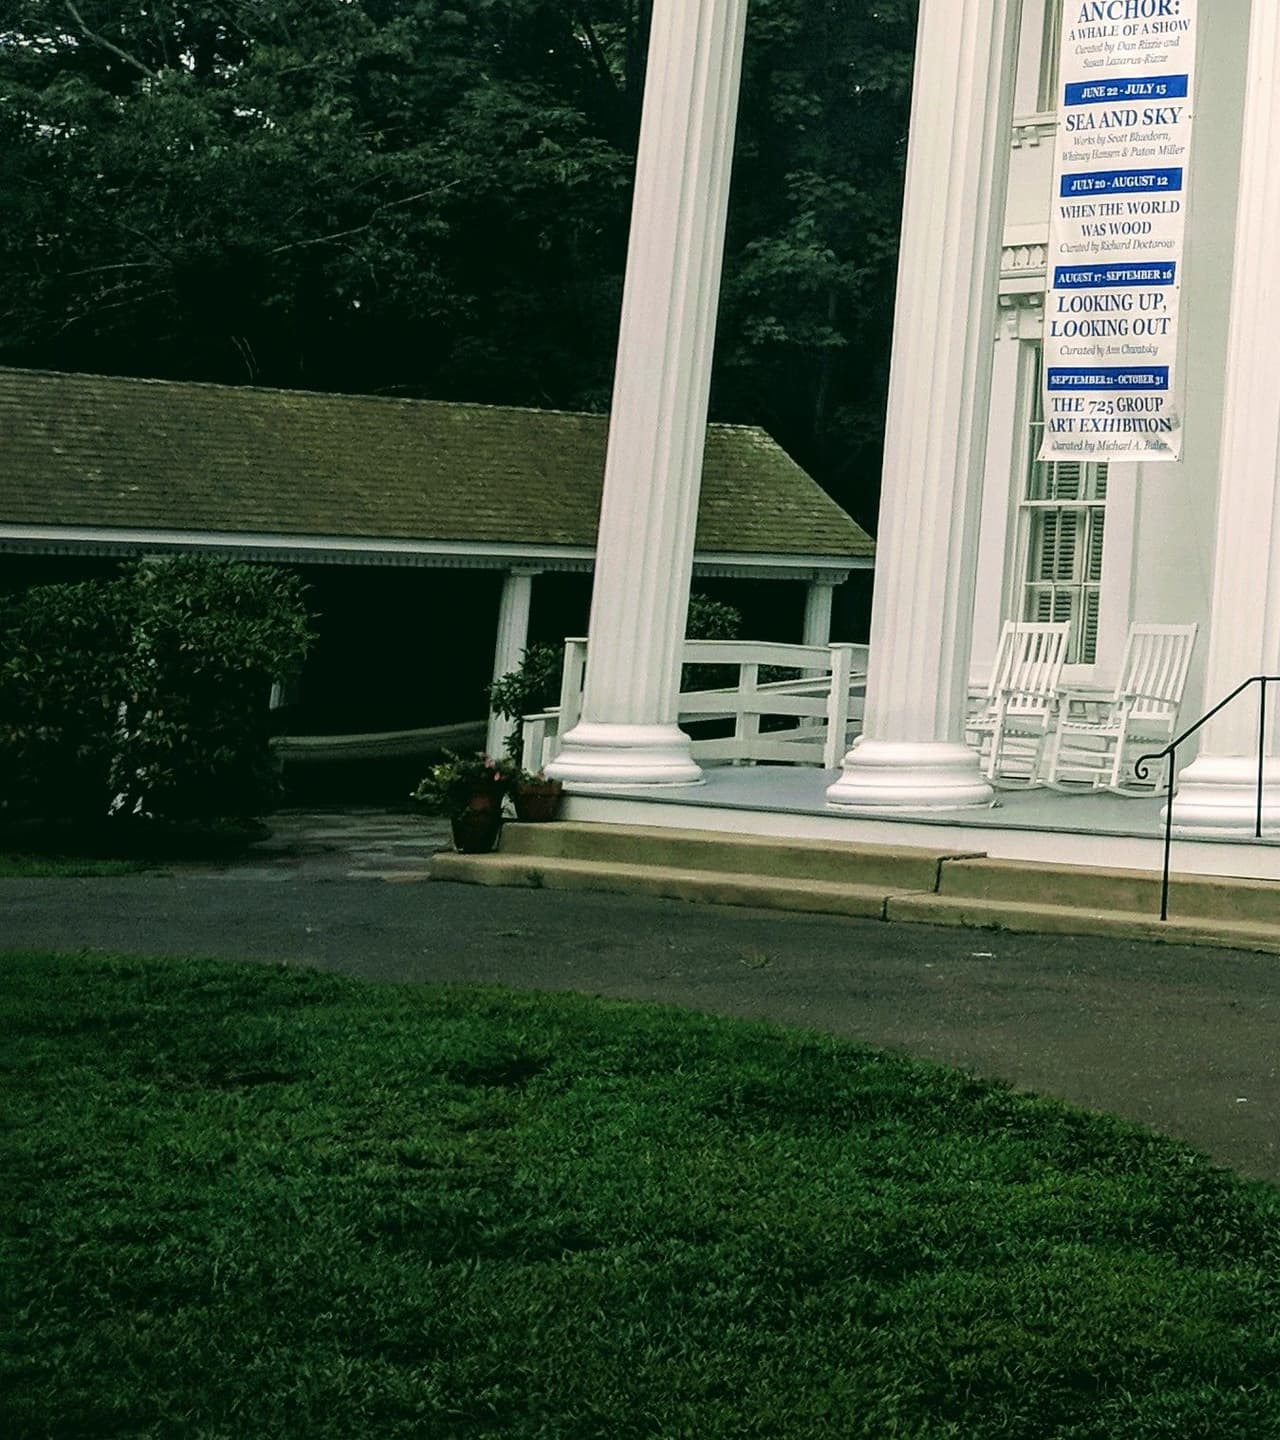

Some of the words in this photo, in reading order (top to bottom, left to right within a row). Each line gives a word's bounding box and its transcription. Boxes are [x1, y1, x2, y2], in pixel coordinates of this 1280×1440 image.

[1069, 30, 1076, 41] A
[1078, 25, 1119, 38] WHALE
[1122, 25, 1139, 36] OF
[1142, 24, 1149, 34] A
[1152, 19, 1191, 33] SHOW
[1075, 42, 1103, 55] Curated
[1104, 41, 1114, 52] by
[1117, 42, 1136, 51] Dan
[1163, 36, 1180, 47] and
[1082, 87, 1106, 99] JUNE
[1107, 88, 1118, 96] 22
[1125, 83, 1155, 94] JULY
[1156, 85, 1167, 95] 15
[1066, 112, 1095, 132] SEA
[1099, 109, 1138, 128] AND
[1142, 107, 1183, 125] SKY
[1074, 136, 1095, 146] Works
[1097, 134, 1106, 146] by
[1107, 133, 1127, 144] Scott
[1122, 148, 1129, 157] &
[1158, 145, 1185, 156] Miller
[1071, 179, 1094, 191] JULY
[1095, 180, 1105, 189] 20
[1112, 176, 1156, 187] AUGUST
[1157, 178, 1168, 186] 12
[1060, 204, 1097, 219] WHEN
[1099, 203, 1124, 216] THE
[1127, 200, 1180, 215] WORLD
[1081, 223, 1106, 237] WAS
[1109, 222, 1151, 235] WOOD
[1060, 241, 1089, 253] Curated
[1091, 240, 1100, 253] by
[1058, 272, 1093, 283] AUGUST
[1094, 273, 1101, 282] 17
[1107, 270, 1161, 281] SEPTEMBER
[1163, 270, 1172, 279] 16
[1057, 294, 1133, 312] LOOKING
[1139, 293, 1167, 311] UP,
[1051, 319, 1128, 337] LOOKING
[1133, 318, 1171, 335] OUT
[1060, 344, 1095, 355] Curated
[1096, 344, 1104, 356] by
[1051, 375, 1105, 384] SEPTEMBER
[1118, 375, 1154, 384] OCTOBER
[1051, 397, 1085, 411] THE
[1089, 401, 1113, 415] 725
[1117, 397, 1163, 411] GROUP
[1050, 418, 1076, 432] ART
[1079, 417, 1172, 433] EXHIBITION
[1052, 439, 1083, 450] Curated
[1084, 440, 1095, 451] by
[1096, 440, 1132, 451] Michael
[1133, 441, 1142, 450] A.
